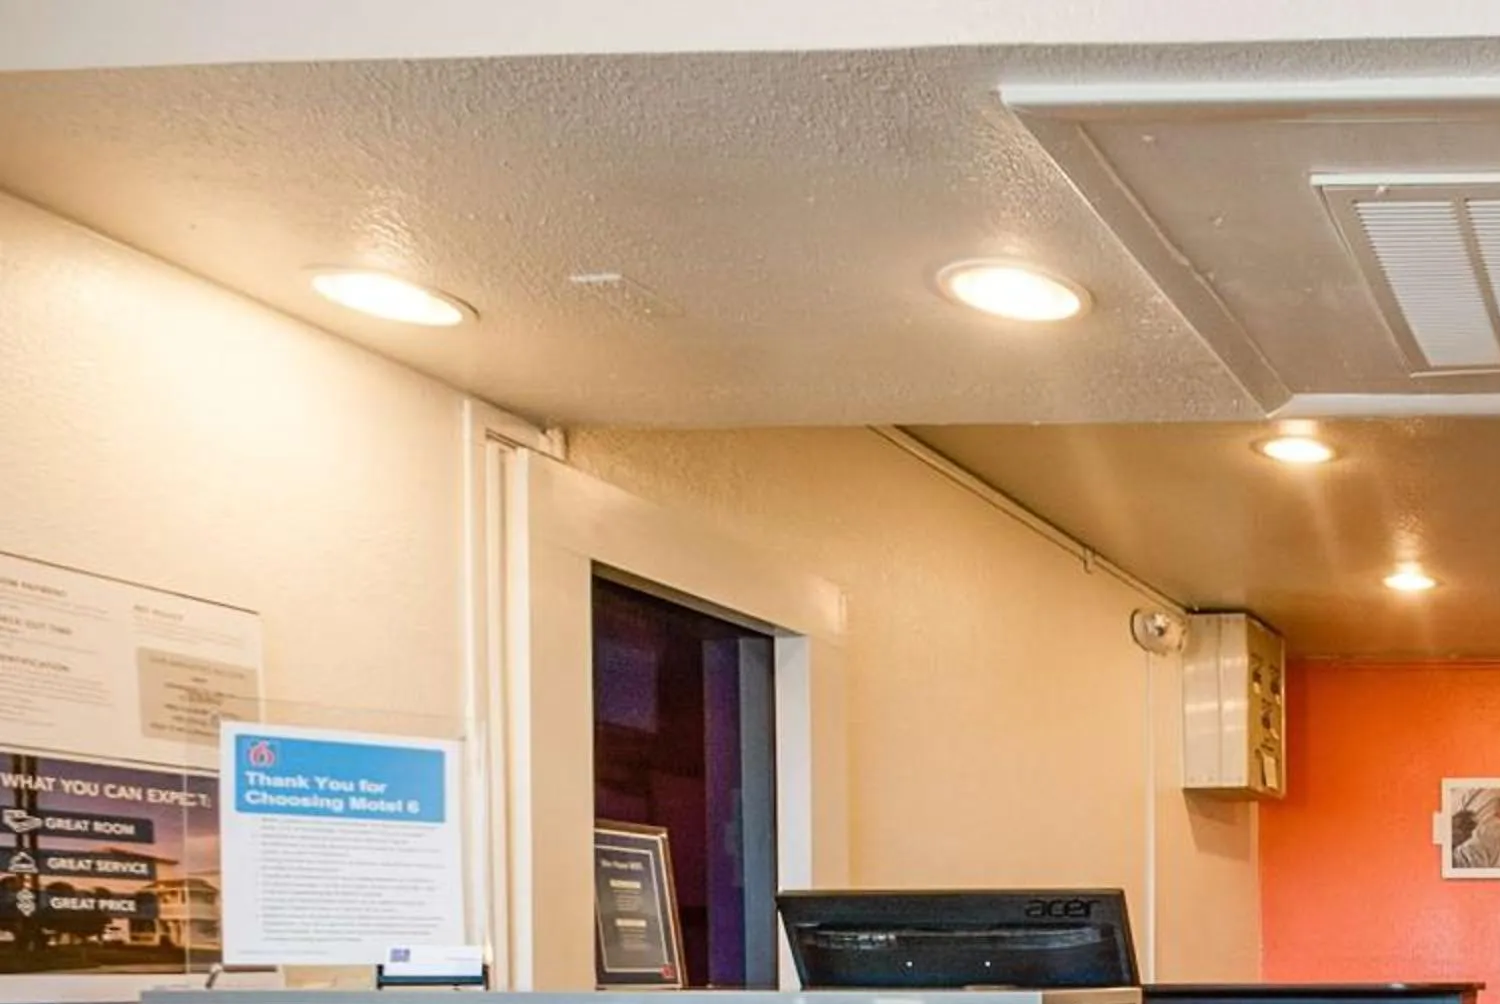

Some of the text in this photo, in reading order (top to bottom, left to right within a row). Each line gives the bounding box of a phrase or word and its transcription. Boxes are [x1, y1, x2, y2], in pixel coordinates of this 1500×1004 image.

[0, 773, 55, 792] WHAT
[61, 780, 99, 796] YOU
[104, 784, 142, 801] CAN
[245, 771, 388, 794] Thank You for
[245, 790, 420, 814] Choosing Motel 6
[45, 817, 135, 835] GREAT ROOM
[47, 857, 149, 875] GREAT SERVICE
[51, 897, 137, 912] GREAT PRICE
[1024, 899, 1102, 919] acer
